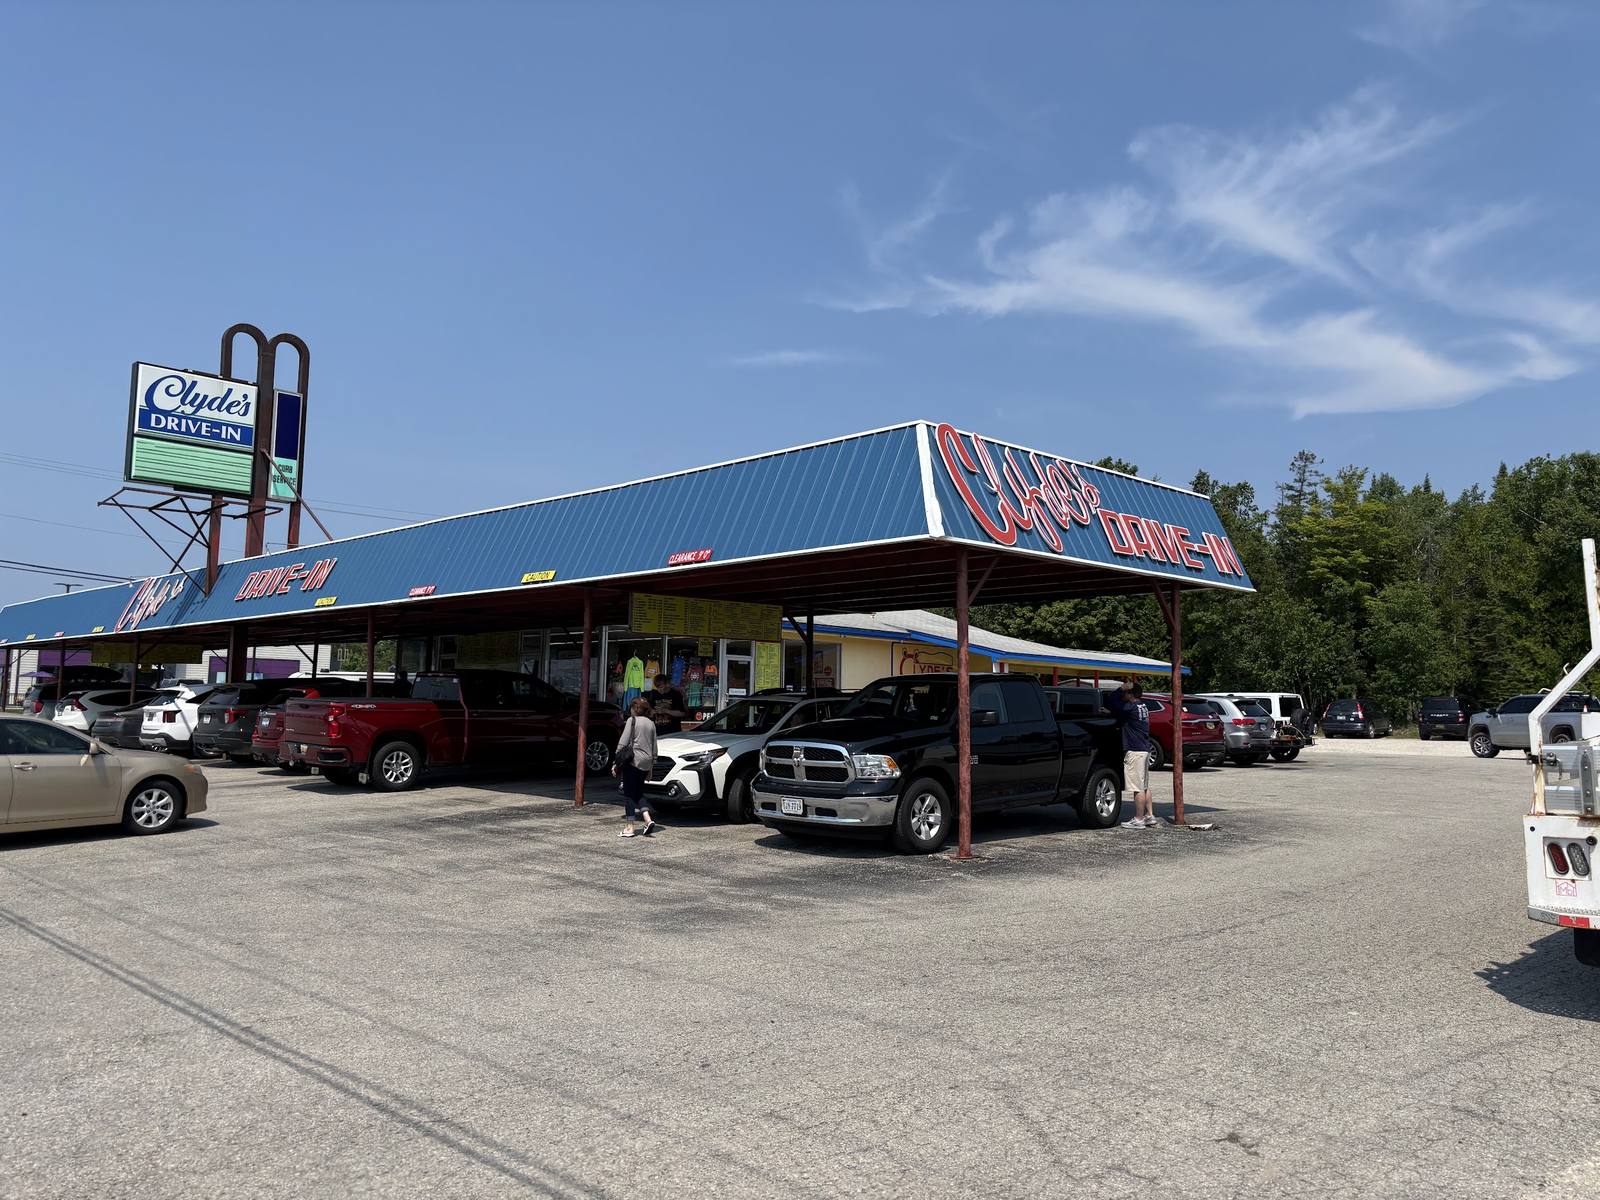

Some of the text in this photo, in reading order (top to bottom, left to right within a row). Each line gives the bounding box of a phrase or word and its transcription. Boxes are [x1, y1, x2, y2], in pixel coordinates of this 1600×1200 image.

[145, 375, 251, 416] Clyde's
[150, 414, 241, 442] DRIVE-IN
[935, 423, 1100, 553] Clyde's
[1097, 507, 1244, 577] DRIVE-IN
[234, 557, 338, 601] DRIVE-IN
[525, 571, 550, 583] CAUTION
